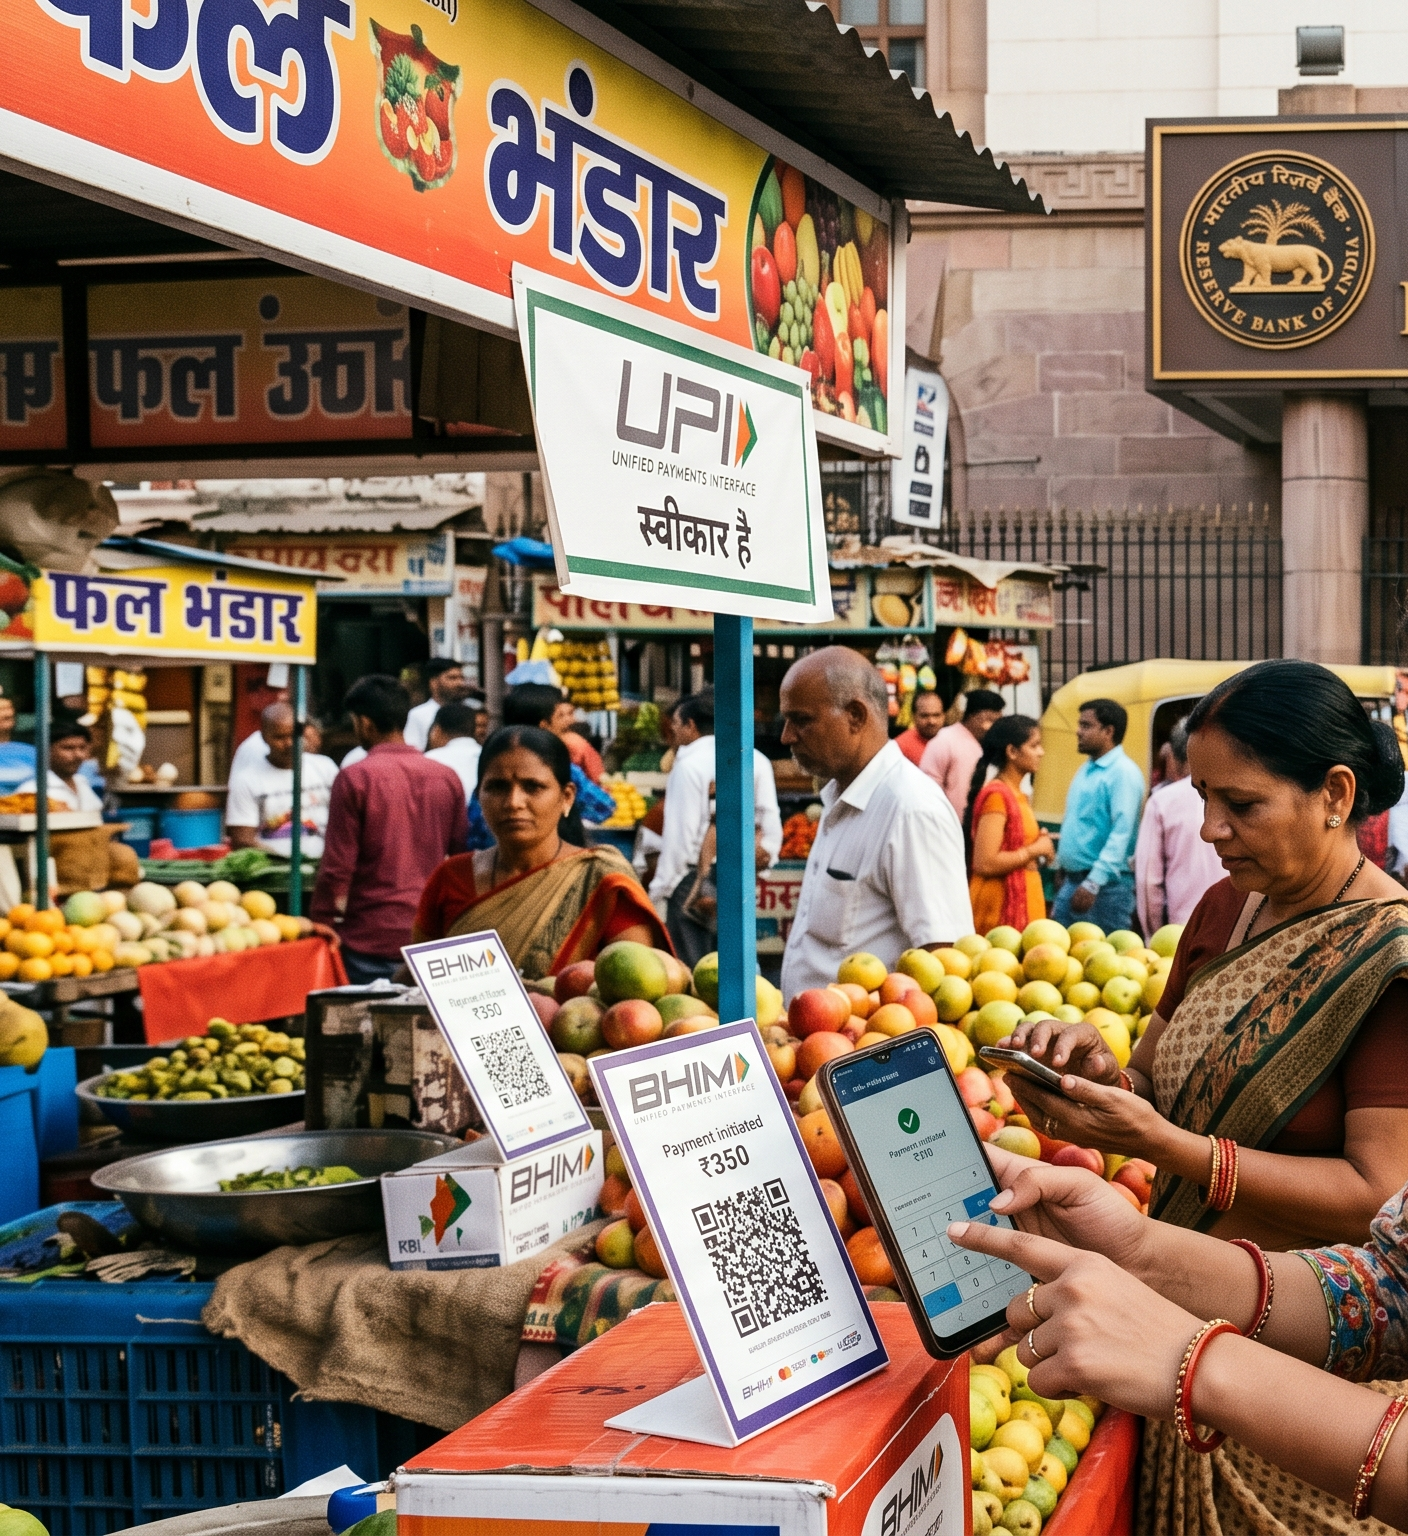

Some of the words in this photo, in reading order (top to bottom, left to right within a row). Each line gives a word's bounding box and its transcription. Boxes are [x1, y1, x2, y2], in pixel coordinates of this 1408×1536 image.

[487, 66, 727, 315] भंडार
[1203, 171, 1267, 226] भारतीय
[1196, 240, 1247, 326] RESERVE
[1251, 313, 1308, 333] BANK
[1311, 296, 1335, 321] OF
[1334, 235, 1360, 296] INDIA
[615, 359, 735, 467] UPI
[612, 450, 654, 474] UNIFIED
[657, 461, 707, 486] PAYMENTS
[710, 473, 756, 497] INTERFACE
[637, 495, 730, 559] स्वीकार
[735, 507, 752, 570] है
[48, 572, 168, 634] फल
[186, 570, 304, 643] भंडार
[427, 950, 489, 979] BHIM
[472, 1002, 502, 1020] ₹350
[629, 1053, 735, 1114] BHIM
[634, 1109, 668, 1125] UNIFIED
[671, 1097, 712, 1114] PAYMENTS
[715, 1083, 756, 1101] INTERFACE
[662, 1131, 716, 1158] Payment
[716, 1114, 764, 1142] initiated
[698, 1144, 750, 1178] ₹350
[511, 1146, 584, 1205] BHIM
[881, 1446, 936, 1536] BHIM
